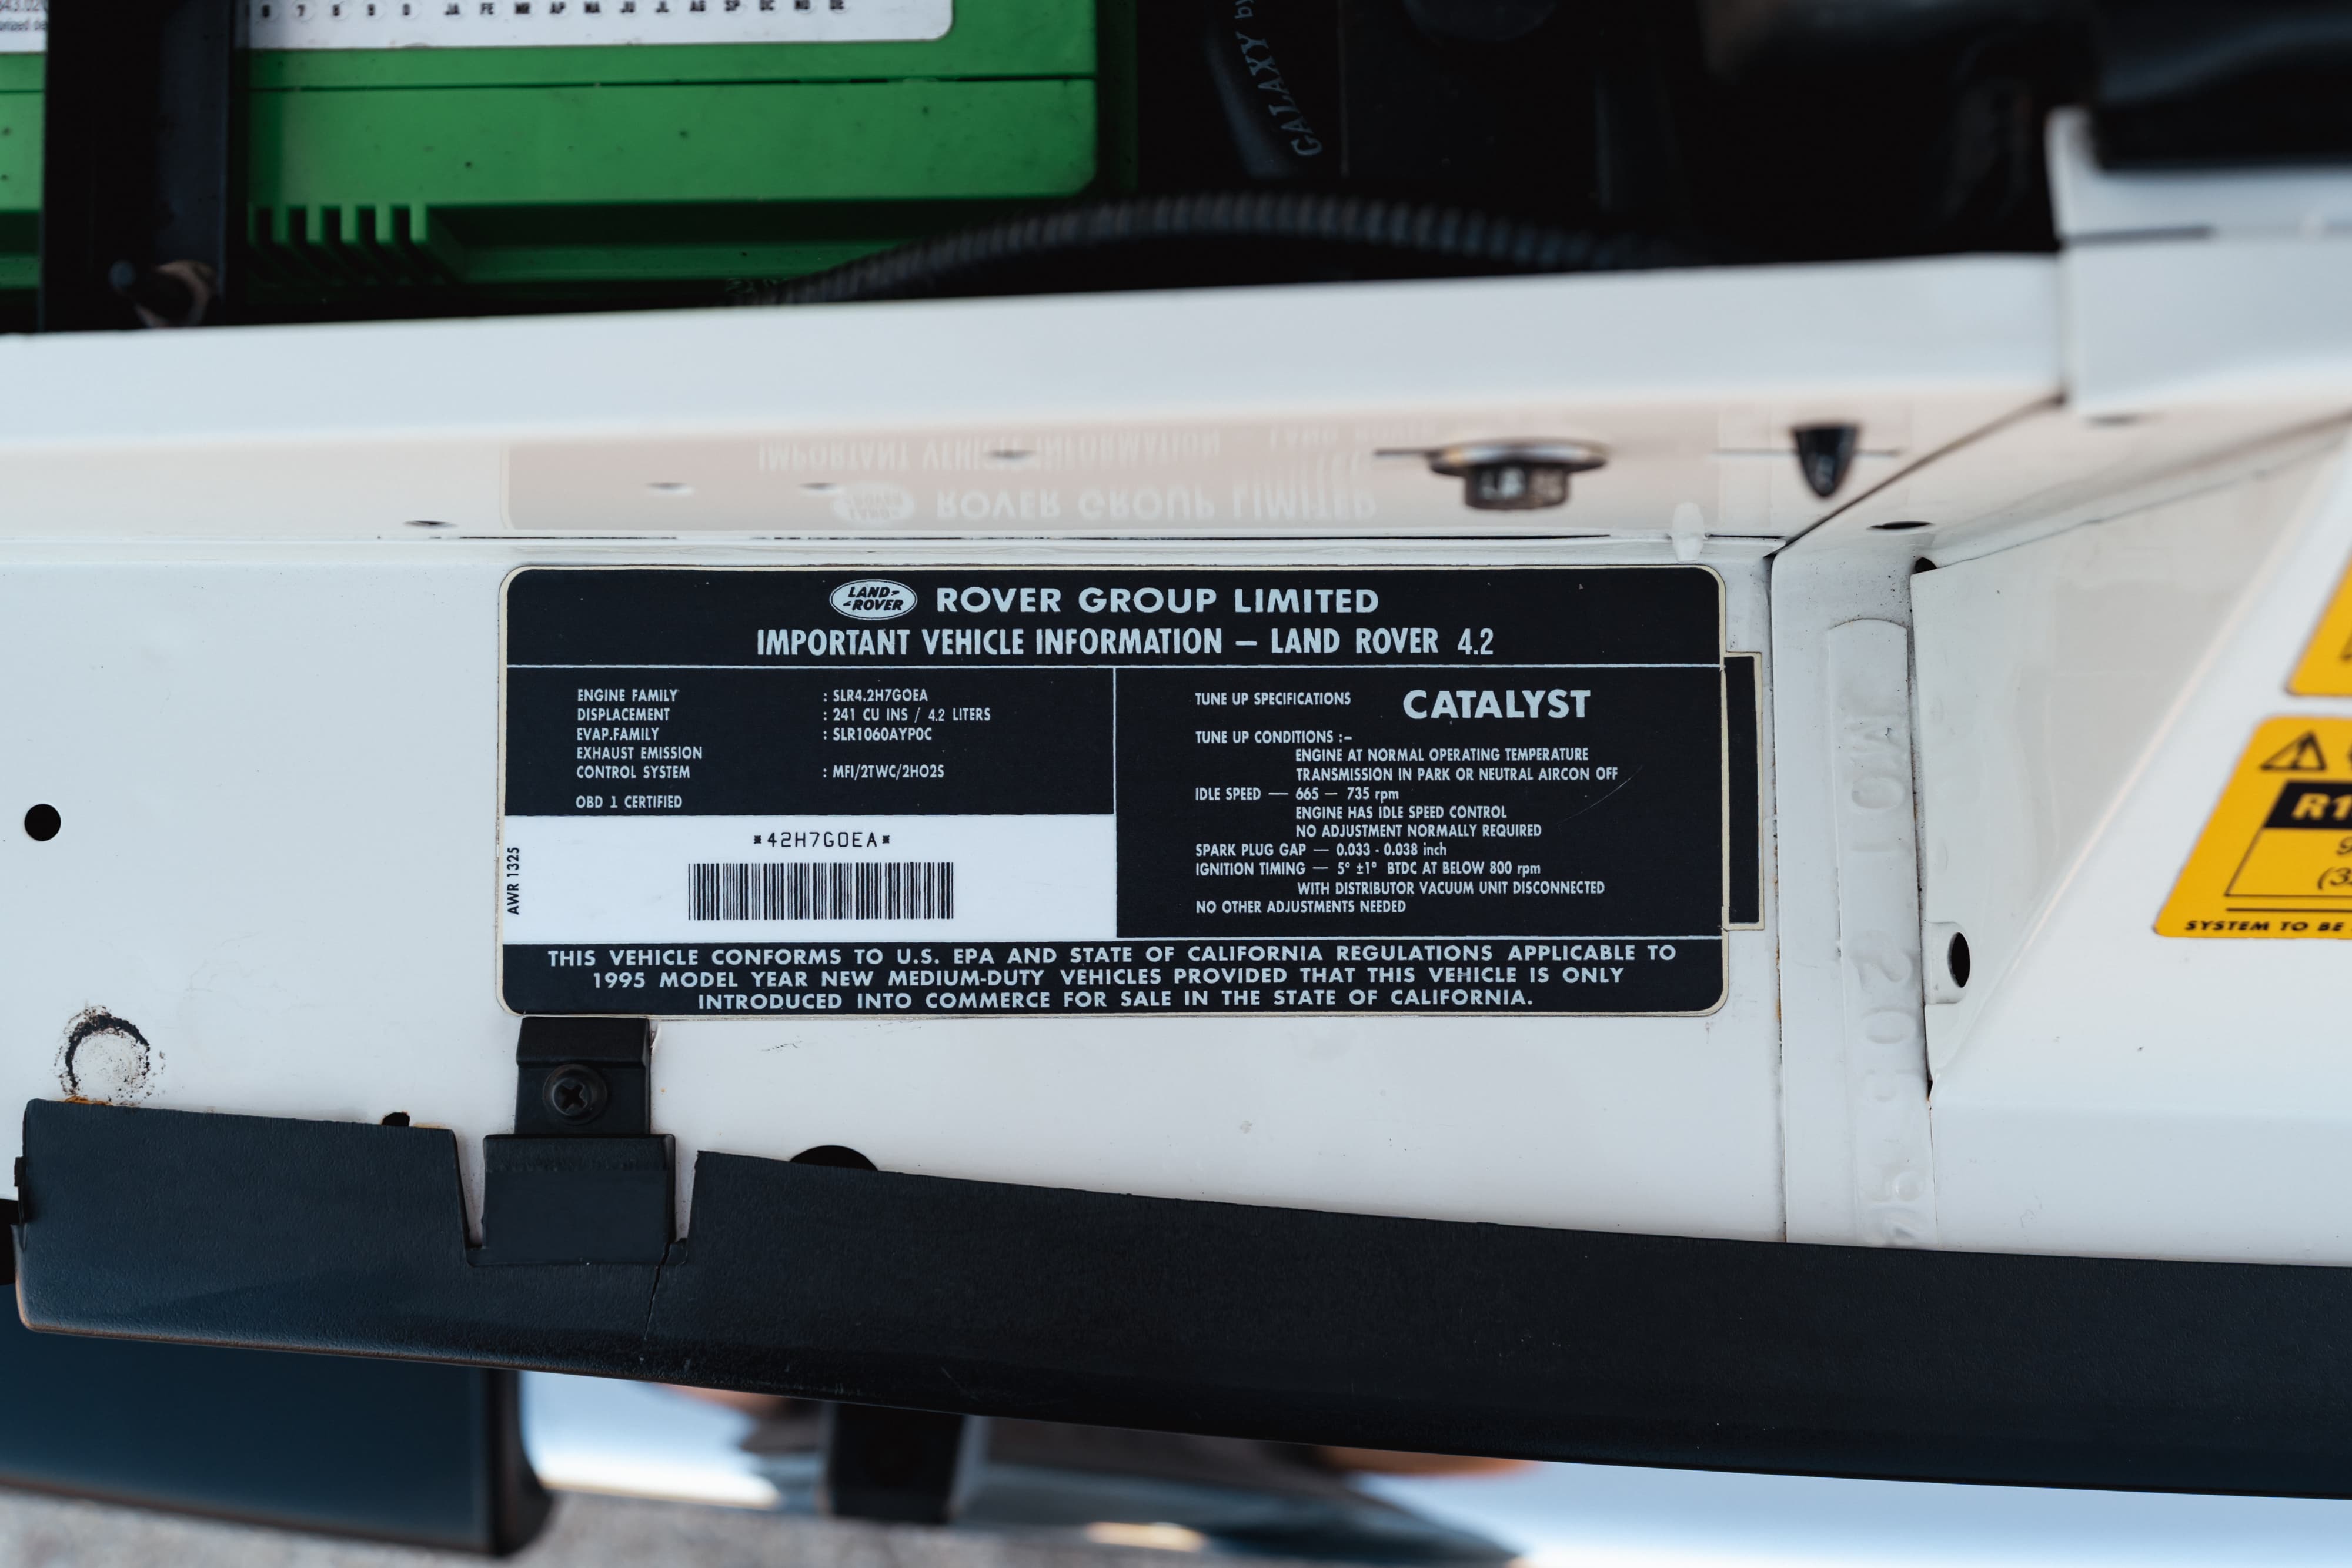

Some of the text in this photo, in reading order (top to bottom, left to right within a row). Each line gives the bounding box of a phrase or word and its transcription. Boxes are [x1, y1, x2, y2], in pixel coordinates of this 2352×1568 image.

[297, 4, 305, 17] 7
[445, 2, 460, 15] JA
[480, 2, 495, 15] FE
[550, 2, 566, 14] AP
[725, 0, 740, 11] SP
[1235, 31, 1323, 156] GALAXY
[937, 586, 1379, 614] ROVER GROUP LIMITED
[757, 627, 1494, 656] IMPORTANT VEHICLE INFORMATION LAND ROVER 4.2
[577, 688, 678, 702] ENGINE FAMILY
[1195, 691, 1351, 706] TUNE UP SPECIFICATIONS
[1403, 688, 1591, 720] CATALYST
[577, 707, 670, 721] DISPLACEMENT
[833, 707, 991, 721] 241 CU INS 4.2 LITERS
[577, 727, 659, 741] EVAP.FAMILY
[1195, 730, 1334, 744] TUNE UP CONDITIONS
[577, 746, 702, 760] EXHAUST EMISSION
[1295, 747, 1589, 762] ENGINE AT NORMAL OPERATING TEMPERATURE
[576, 765, 690, 779] CONTROL SYSTEM
[1296, 767, 1618, 781] TRANSMISSION IN PARK OR NEUTRAL AIRCON OFF
[576, 795, 683, 808] OBD 1 CERTIFIED
[1195, 786, 1399, 804] IDLE SPEED 665 735 rpm
[1296, 805, 1507, 820] ENGINE HAS IDLE SPEED CONTROL
[1296, 824, 1542, 838] NO ADJUSTMENT NORMALLY REQUIRED
[1195, 841, 1446, 857] SPARK PLUG GAP 0.033 0.038 inch
[1196, 862, 1254, 876] IGNITION
[1259, 862, 1306, 875] TIMING
[1387, 861, 1417, 875] BTDC
[1422, 861, 1438, 875] AT
[1442, 861, 1485, 875] BELOW
[1489, 860, 1512, 875] 800
[1517, 865, 1541, 878] rpm
[507, 847, 519, 915] AWR 1325
[1297, 881, 1605, 895] WITH DISTRIBUTOR VACUUM UNIT DISCONNECTED
[1196, 900, 1406, 914] NO OTHER ADJUSTMENTS NEEDED
[2184, 920, 2345, 932] SYSTEM TO BE
[547, 944, 1676, 967] THIS VEHICLE CONFORMS TO U.S. EPA AND STATE OF CALIFORNIA REGULATIONS APPLICABLE TO
[593, 967, 1624, 988] 1995 MODEL YEAR NEW MEDIUM-DUTY VEHICLES PROVIDED THAT THIS VEHICLE IS ONLY
[699, 989, 1532, 1009] INTRODUCED INTO COMMERCE FOR SALE IN THE STATE OF CALIFORNIA.
